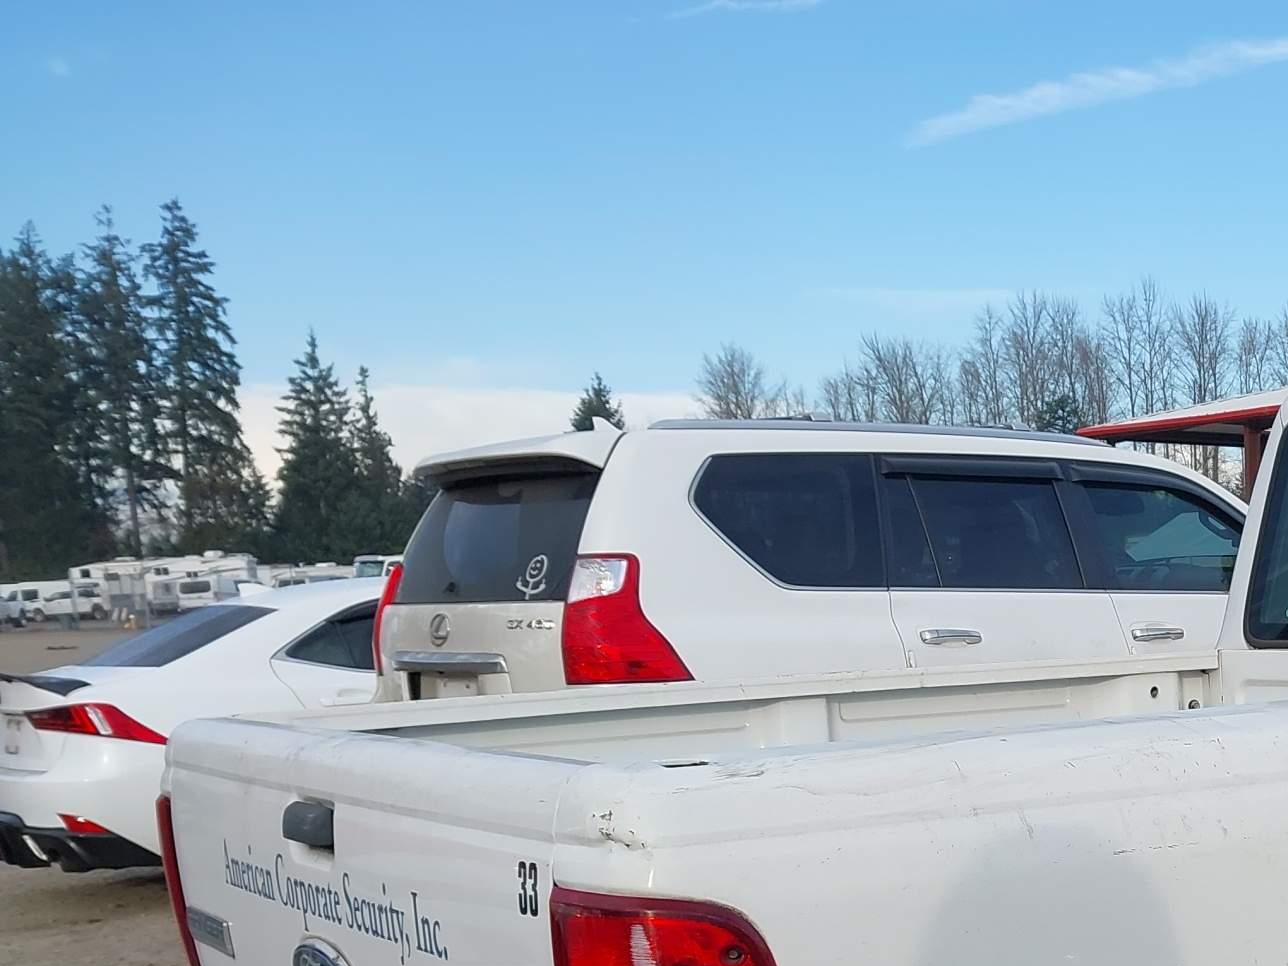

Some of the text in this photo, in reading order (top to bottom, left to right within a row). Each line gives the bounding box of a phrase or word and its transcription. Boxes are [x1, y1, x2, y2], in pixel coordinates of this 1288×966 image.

[223, 838, 276, 901] American
[275, 853, 342, 933] Corporate
[342, 872, 410, 966] Security,
[410, 891, 449, 961] Inc.
[517, 861, 539, 917] 33
